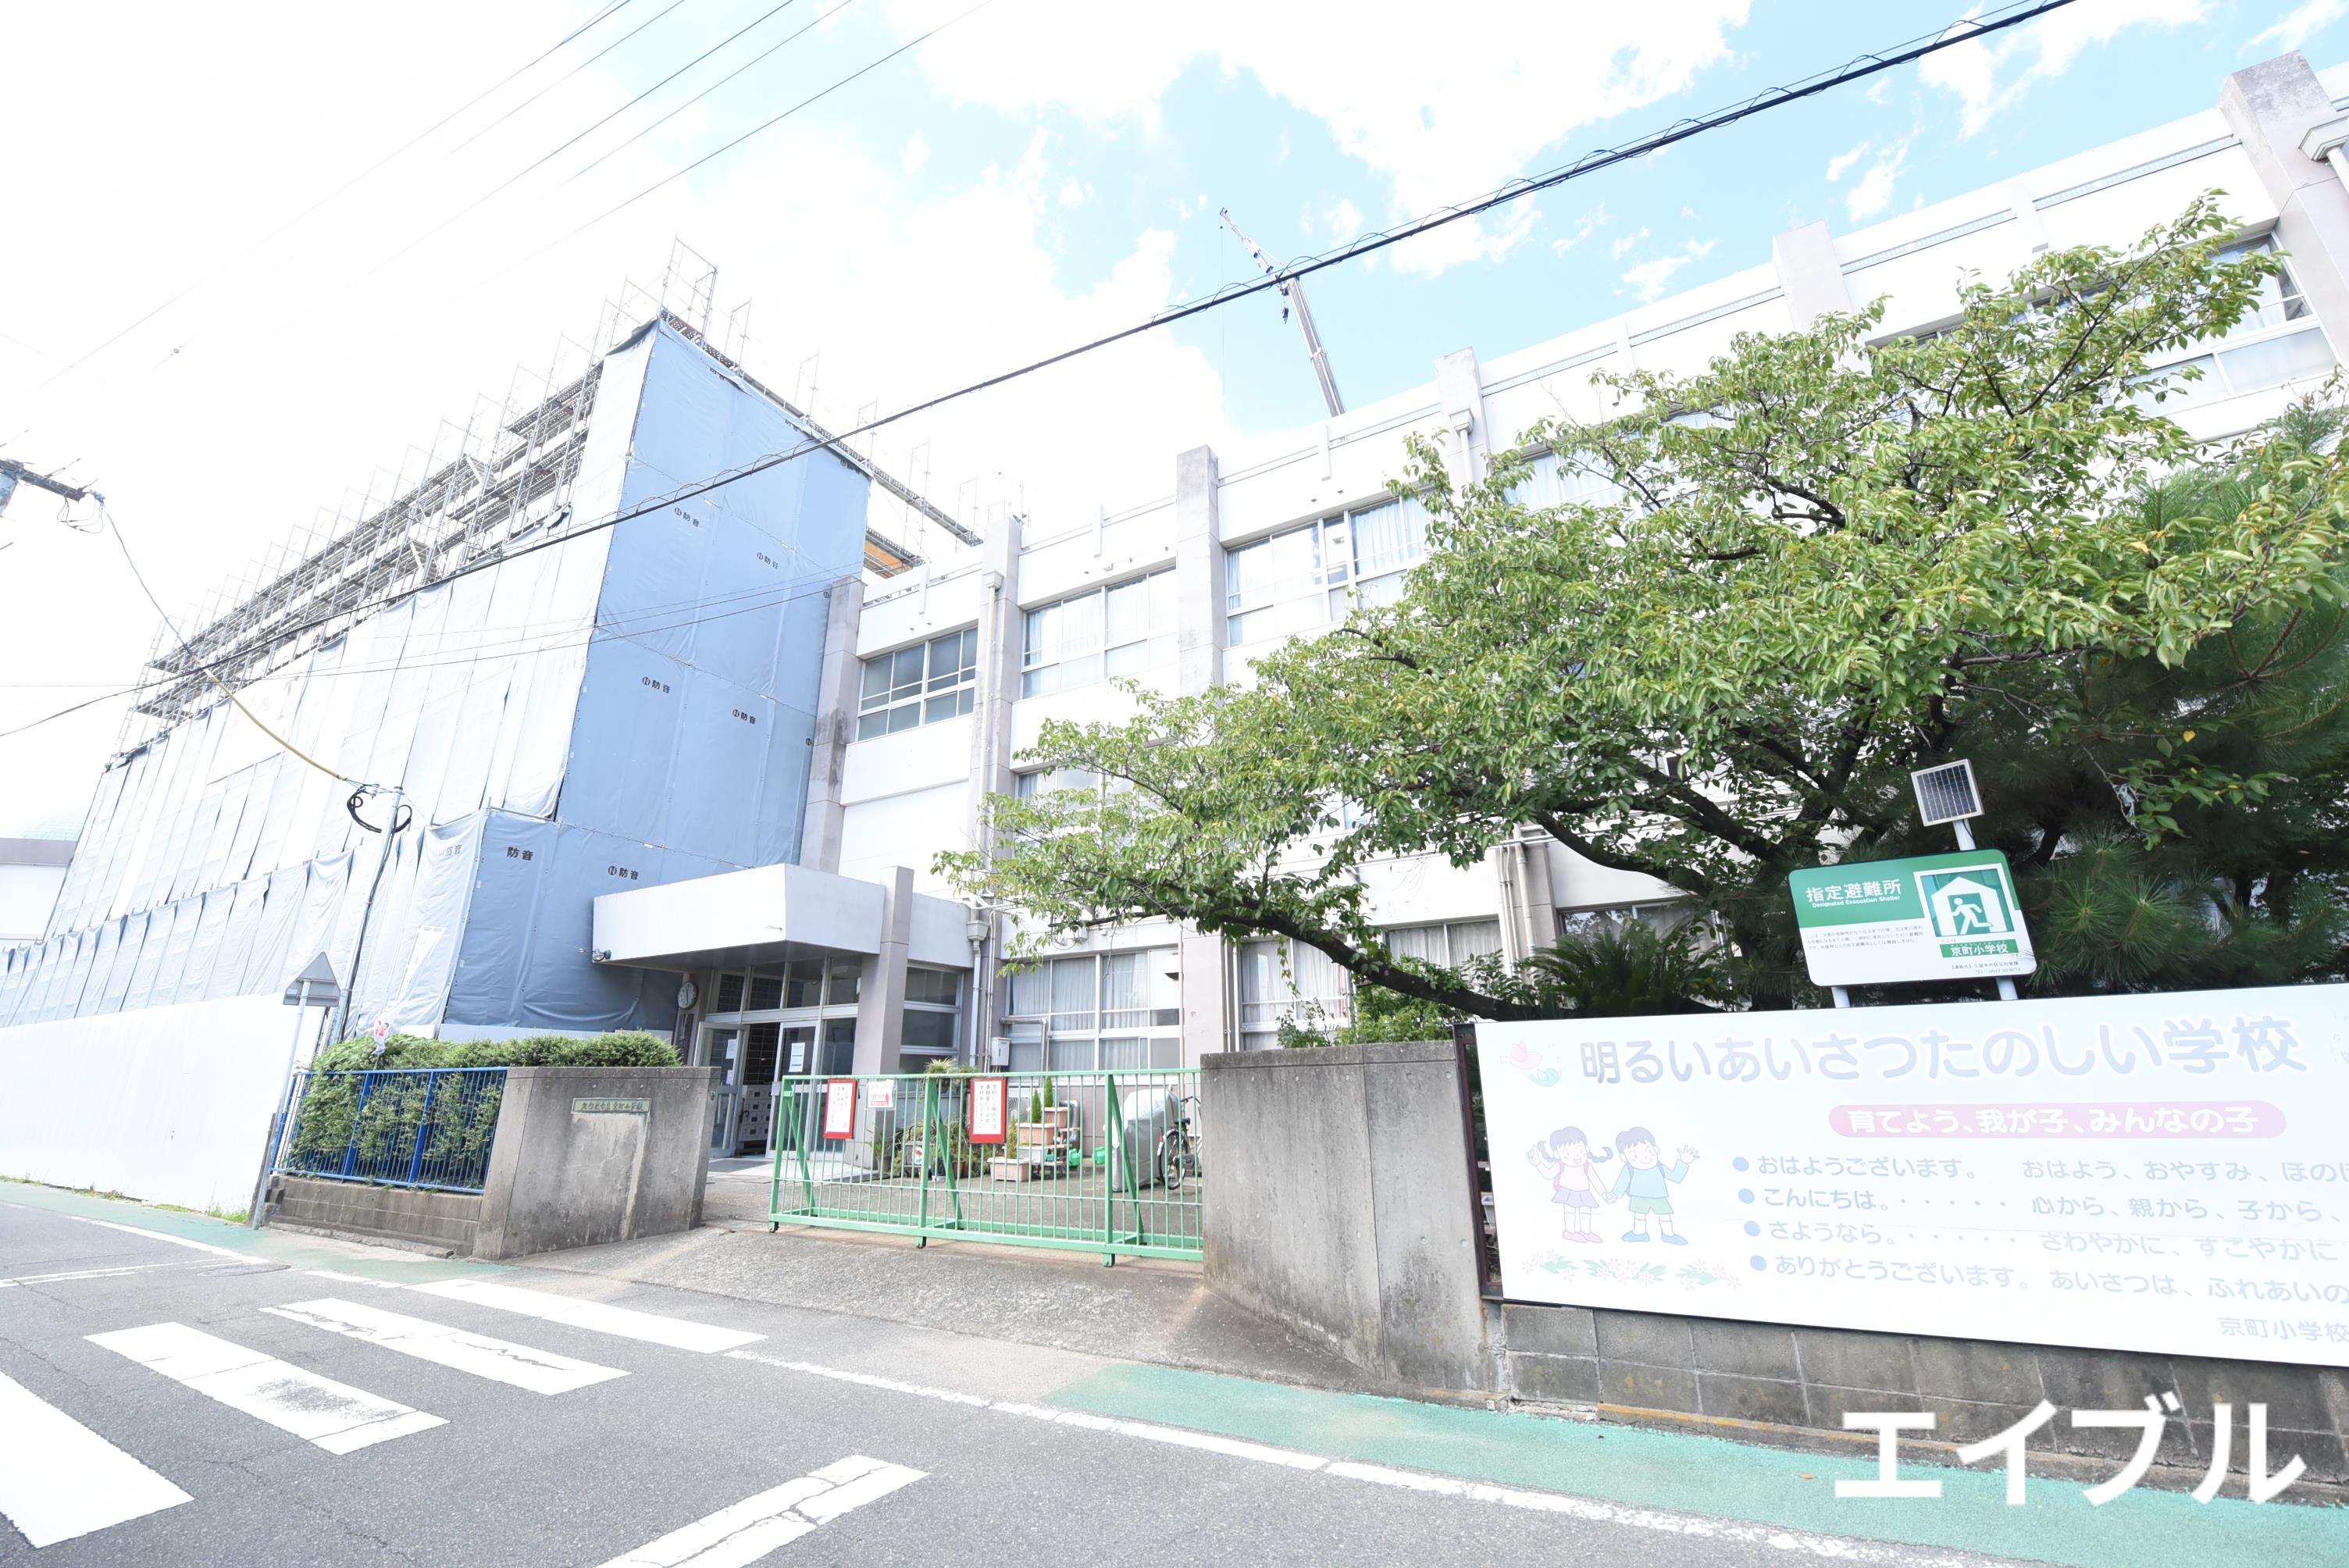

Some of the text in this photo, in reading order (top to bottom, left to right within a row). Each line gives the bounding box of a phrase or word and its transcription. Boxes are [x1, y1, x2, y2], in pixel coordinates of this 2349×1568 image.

[651, 679, 671, 694] 防音
[740, 711, 757, 725] 防音
[507, 846, 533, 861] 防音
[618, 867, 640, 881] 防音
[1805, 878, 1902, 903] 指定避難所
[1812, 900, 1845, 908] Designated
[1845, 897, 1878, 906] Evacuation
[1950, 943, 2009, 957] 京町小学校
[1580, 1016, 2308, 1085] 明るいあいさつたのしい学校
[1848, 1106, 2258, 1133] 育てよう、我が子、みんなの子
[1757, 1156, 1976, 1180] おはようございます。
[1774, 1254, 2030, 1290] ありがとうございます。
[2217, 1316, 2349, 1343] 京町小学校
